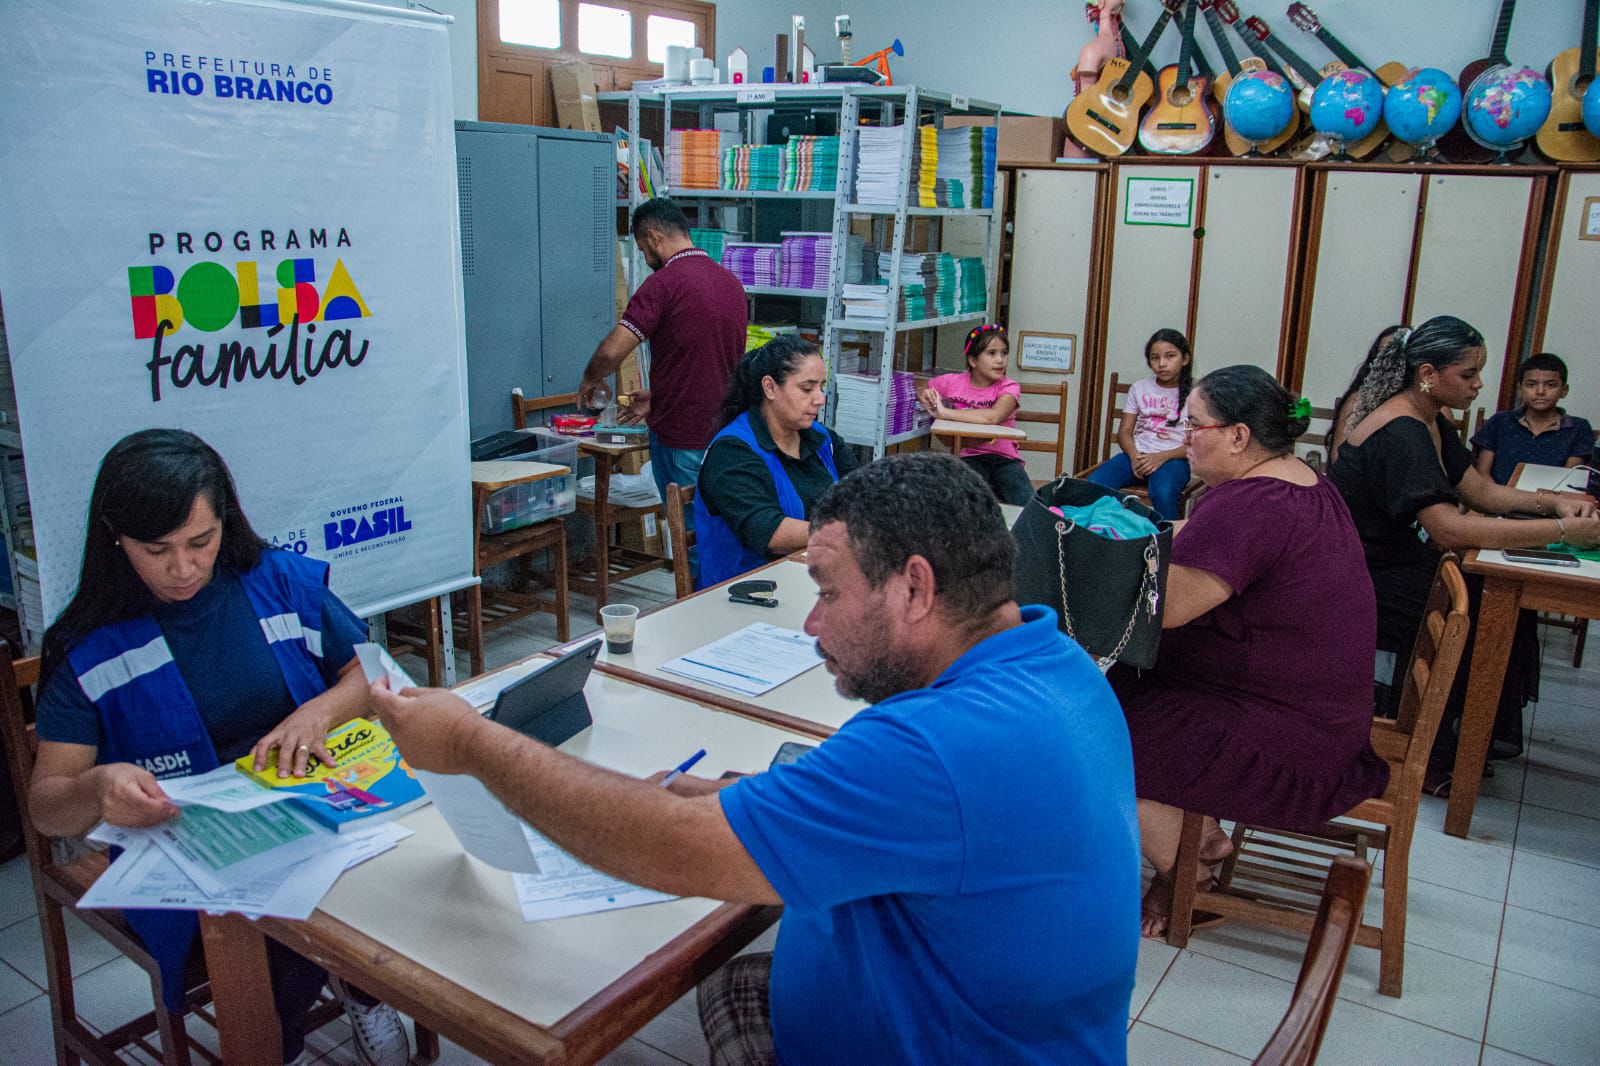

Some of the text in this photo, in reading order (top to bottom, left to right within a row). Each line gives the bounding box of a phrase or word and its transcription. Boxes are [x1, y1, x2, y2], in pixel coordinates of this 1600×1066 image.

[145, 51, 333, 81] PREFEITURA DE
[145, 69, 333, 105] RIO BRANCO
[149, 228, 352, 255] PROGRAMA
[128, 257, 373, 340] BOLSA
[146, 313, 370, 402] família
[330, 496, 404, 518] GOVERNO FEDERAL
[288, 528, 307, 541] DE
[324, 506, 412, 551] BRASIL
[333, 550, 353, 559] UNIÃO
[360, 536, 406, 552] RECONSTRUÇÃO
